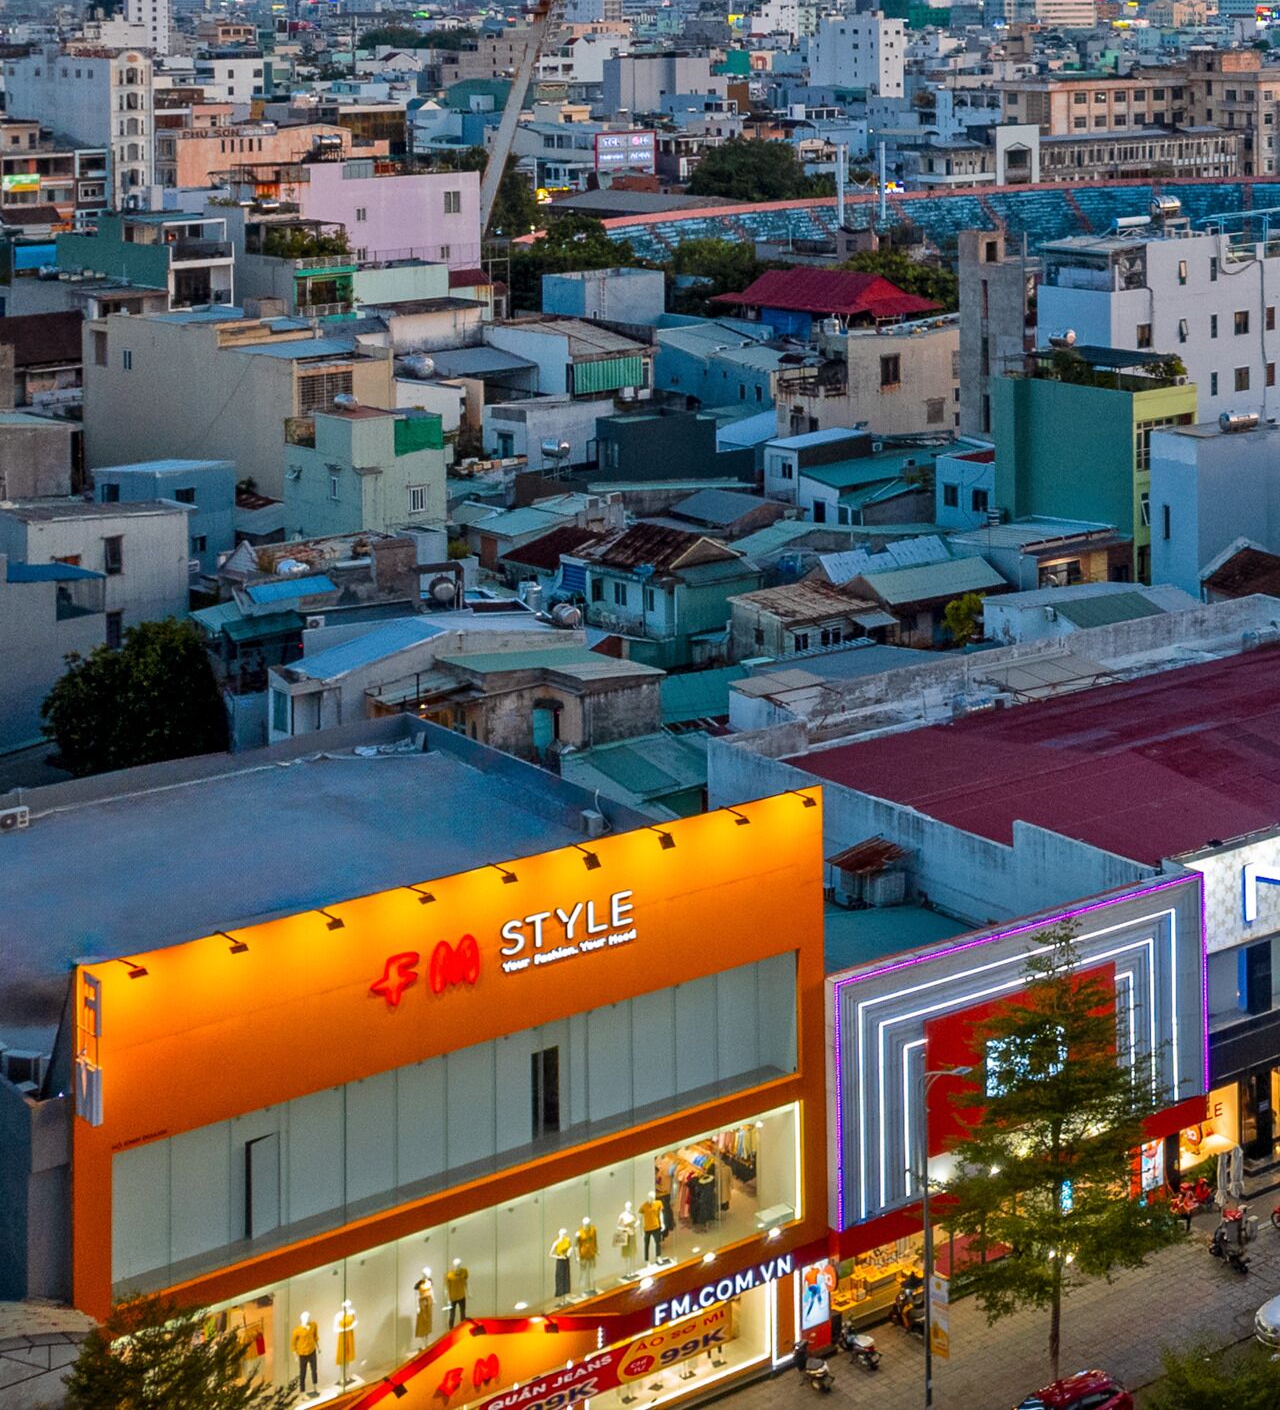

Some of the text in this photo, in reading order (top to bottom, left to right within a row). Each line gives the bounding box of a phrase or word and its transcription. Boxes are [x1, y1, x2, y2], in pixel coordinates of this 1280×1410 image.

[500, 889, 635, 957] STYLE
[370, 933, 481, 1008] FM
[652, 1254, 793, 1327] FM.COM.VN
[552, 1354, 613, 1388] JEANS
[660, 1325, 730, 1366] 99K
